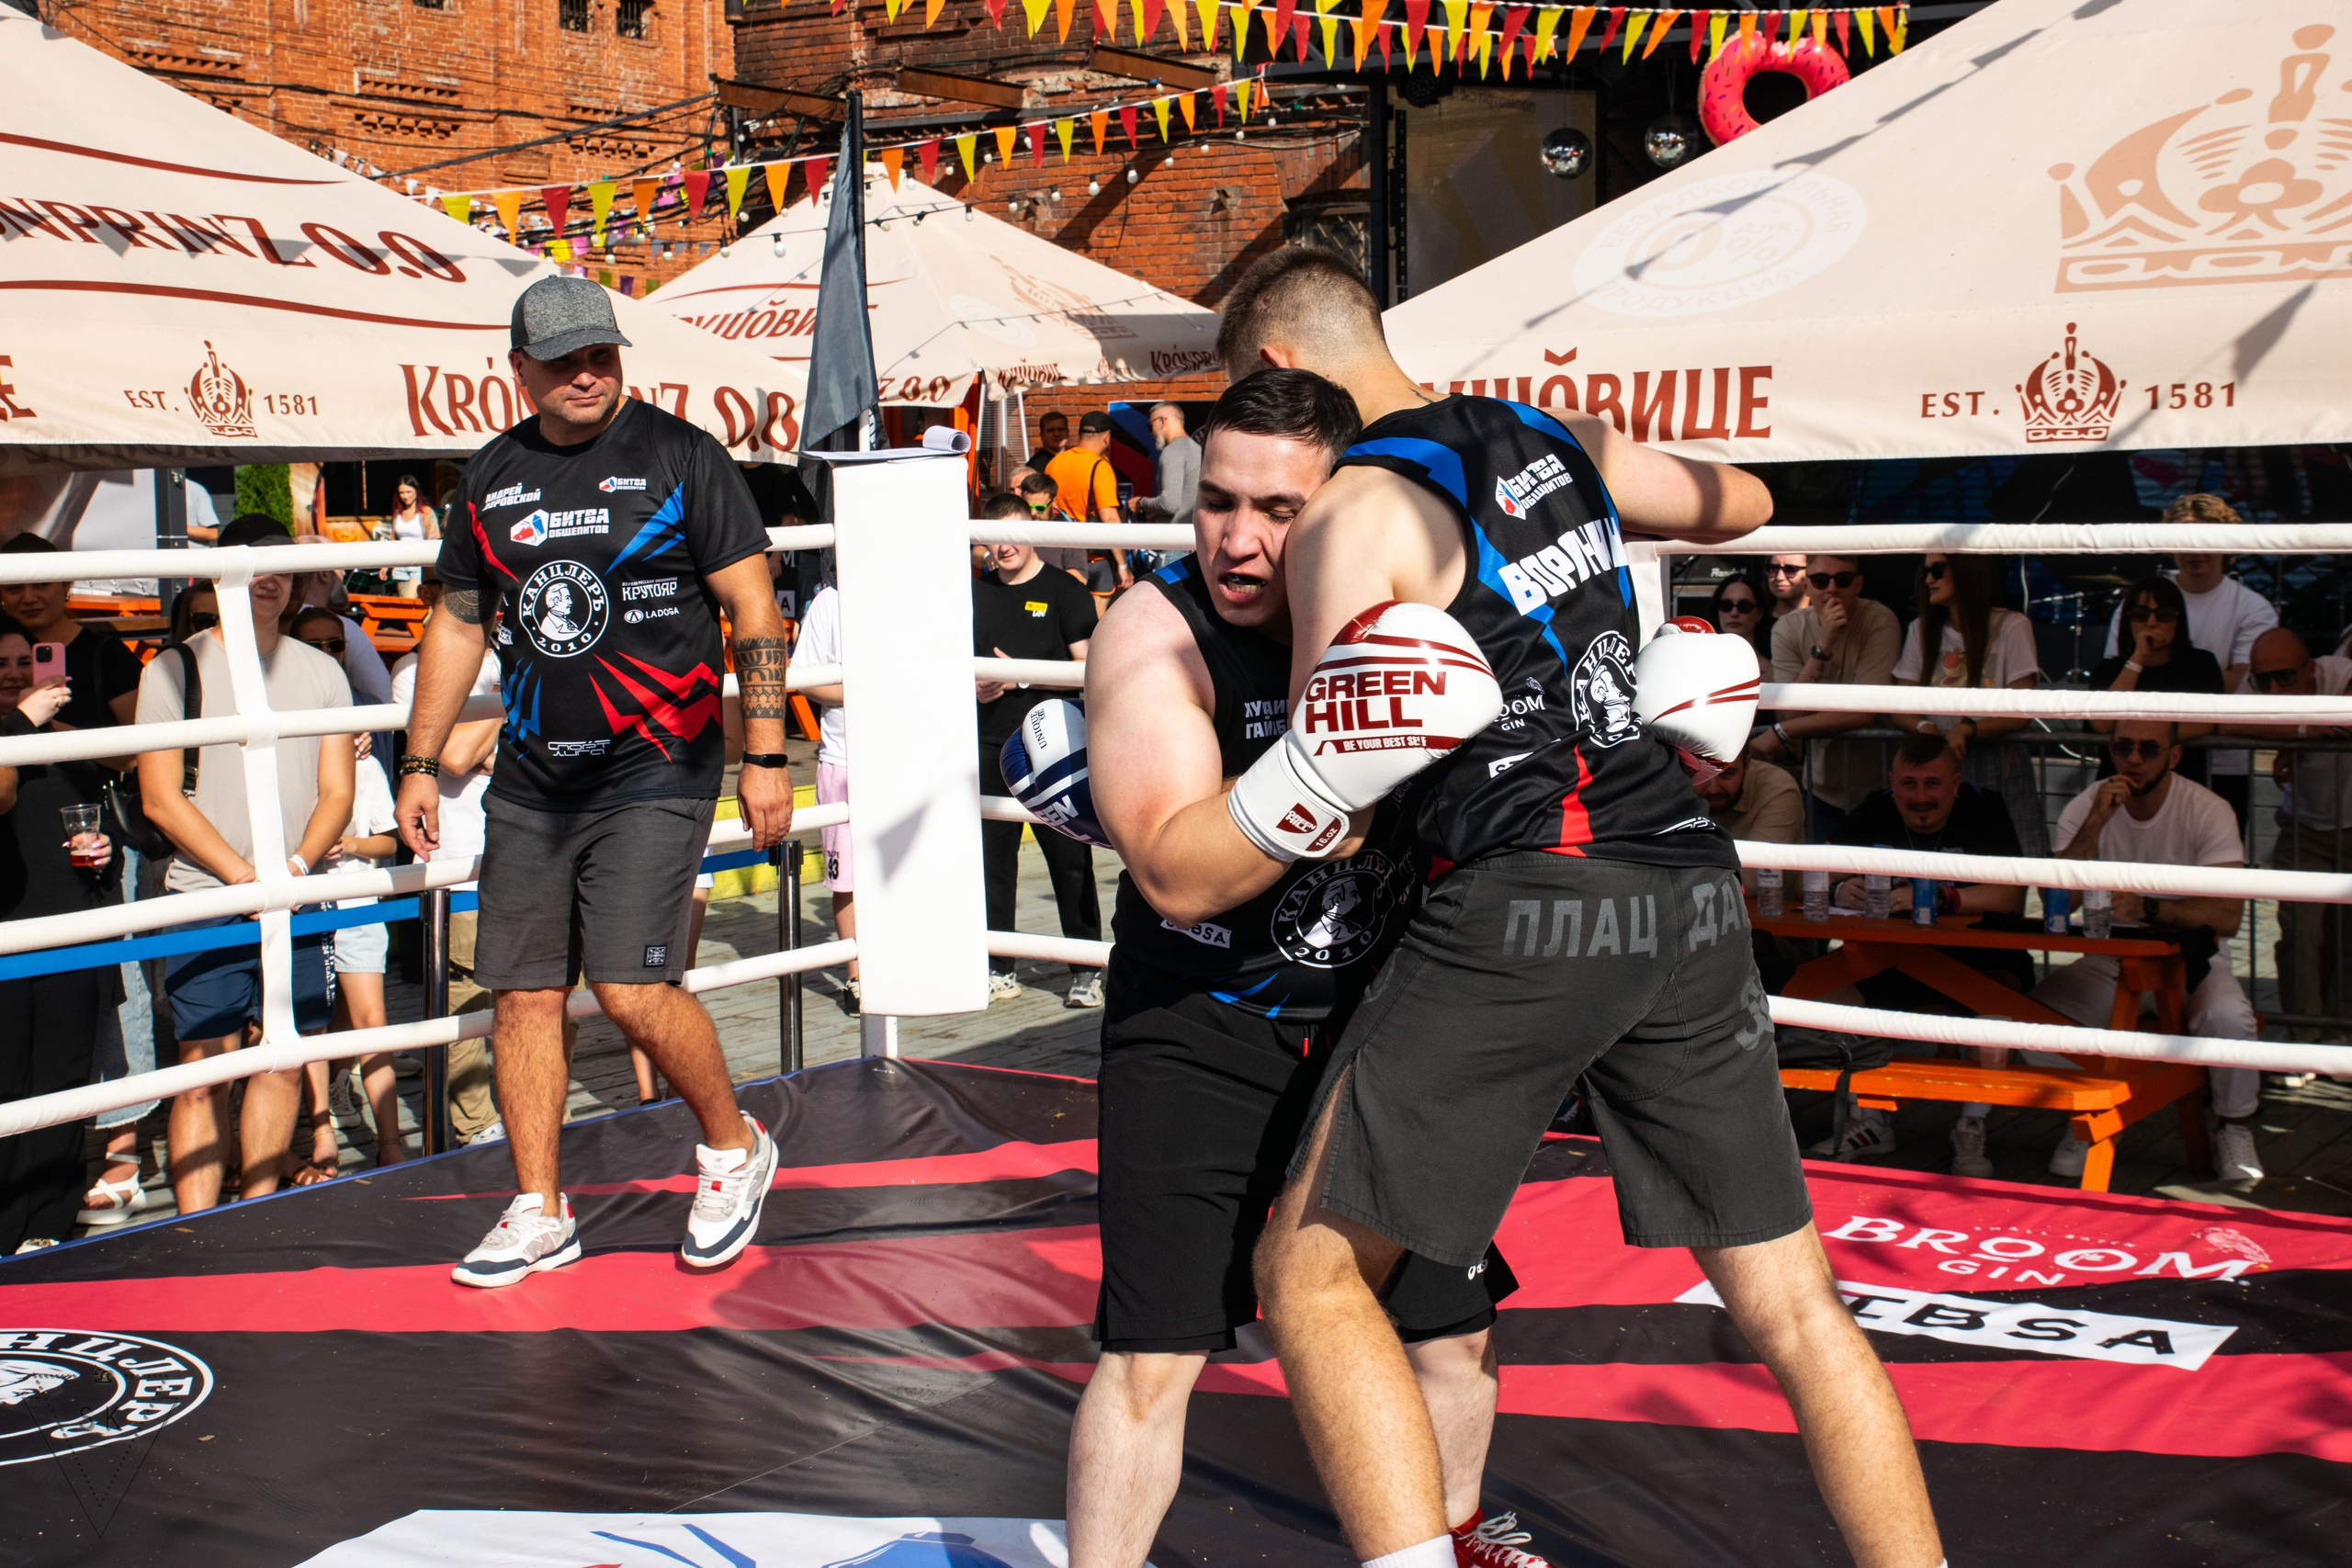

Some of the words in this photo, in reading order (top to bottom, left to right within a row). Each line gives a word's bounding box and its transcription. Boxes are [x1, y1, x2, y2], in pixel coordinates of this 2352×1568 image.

[0, 197, 318, 268] NPRINZ
[300, 222, 468, 283] 0.0
[899, 376, 951, 402] 0.0
[1921, 391, 2000, 418] EST.
[2144, 381, 2236, 411] 1581
[123, 389, 179, 412] EST.
[264, 394, 318, 416] 1581
[617, 479, 647, 487] БИТВА
[1507, 454, 1566, 498] БИТВА
[485, 482, 523, 503] АНДРЕЙ
[549, 508, 610, 528] БИТВА
[548, 525, 609, 538] ОБЩЕПИТОВ
[523, 564, 605, 616] КАНЦЛЕРЪ
[622, 581, 678, 602] КРУТОЯР
[646, 607, 680, 619] LADOGA
[537, 633, 592, 652] 2010
[1305, 671, 1447, 702] GREEN
[1305, 697, 1423, 734] HILL
[1498, 694, 1546, 716] OOM
[1501, 718, 1525, 731] GIN
[1343, 741, 1355, 751] BE
[1357, 739, 1384, 750] YOUR
[1385, 737, 1406, 749] BEST
[1688, 877, 1750, 953] ДА
[1295, 931, 1373, 962] 2010
[1822, 1215, 2256, 1283] BROOM
[1938, 1259, 2065, 1285] GIN
[1845, 1294, 2176, 1355] IBSA
[0, 1333, 193, 1439] НЦЛЕРЪ
